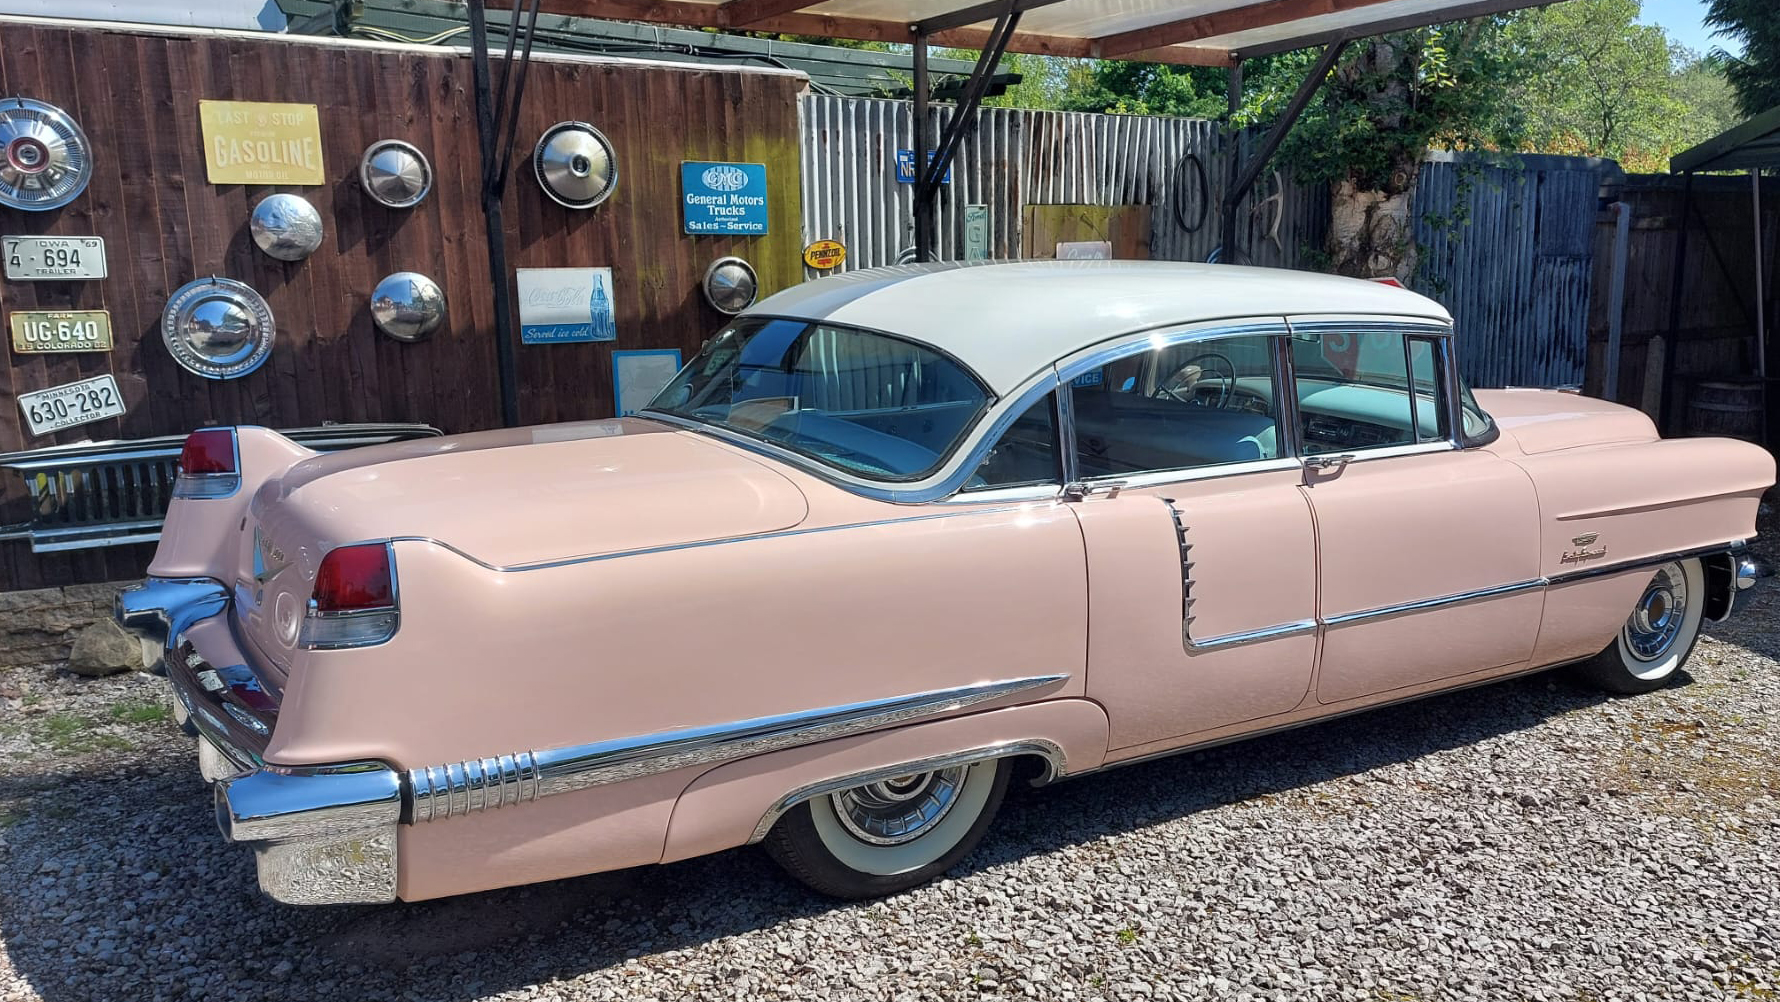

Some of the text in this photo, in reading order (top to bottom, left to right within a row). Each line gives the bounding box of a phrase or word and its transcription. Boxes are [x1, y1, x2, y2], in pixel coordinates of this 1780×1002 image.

[271, 112, 305, 126] STOP
[213, 134, 318, 170] GASOLINE
[686, 193, 764, 206] General Motors
[707, 205, 746, 216] Trucks
[688, 221, 719, 230] Sales
[727, 221, 763, 230] Service
[36, 240, 69, 248] IOWA
[811, 248, 841, 260] PENNZOIL
[23, 320, 98, 342] UG-640
[525, 326, 589, 339] Served ice cold
[36, 341, 92, 350] COLORADO
[30, 387, 116, 424] 630-282
[54, 411, 102, 426] COLLECTOR
